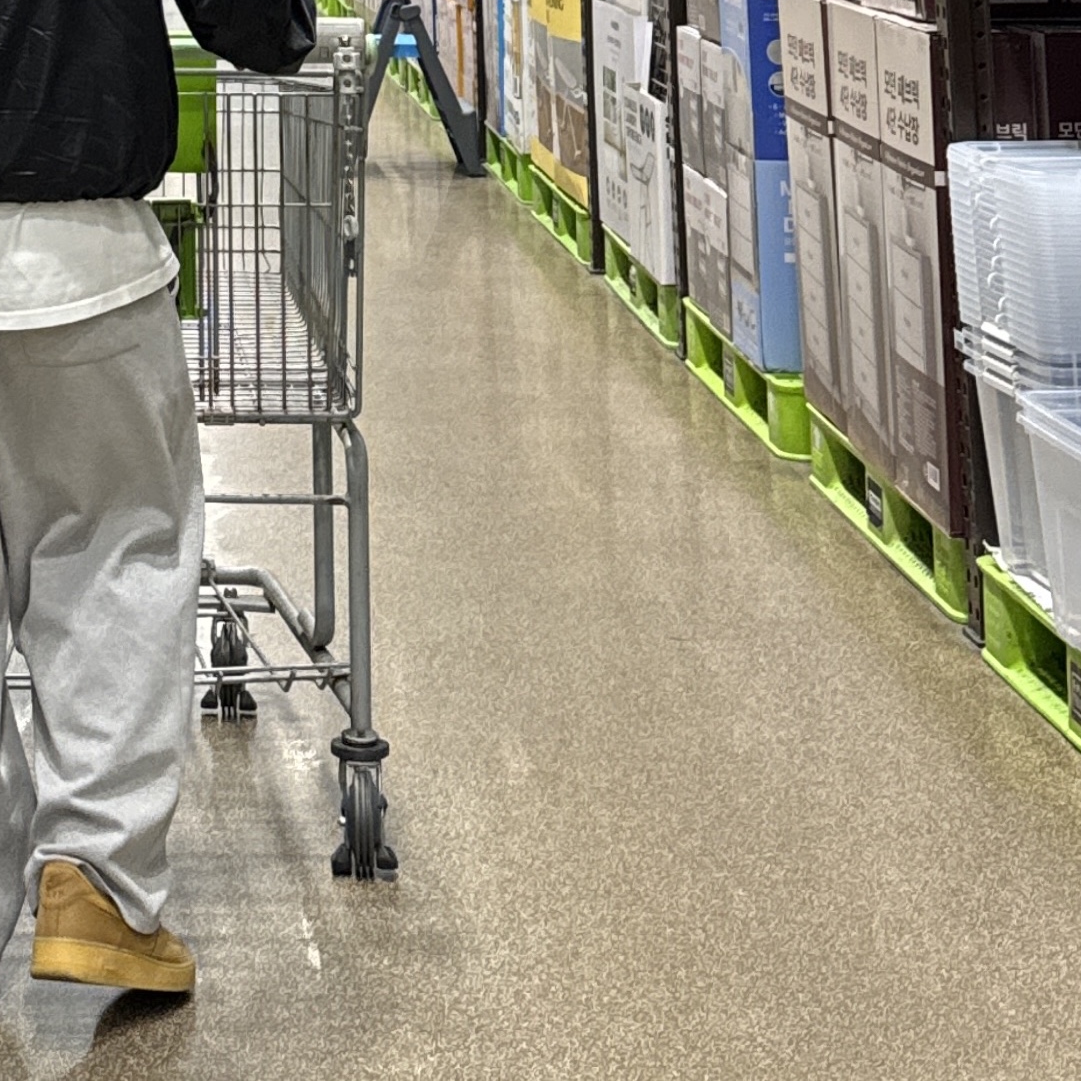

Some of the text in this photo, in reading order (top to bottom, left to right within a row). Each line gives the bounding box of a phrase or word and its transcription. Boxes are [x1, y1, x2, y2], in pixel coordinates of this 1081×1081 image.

[884, 69, 920, 110] 모던 패브릭
[897, 110, 920, 146] 수납장
